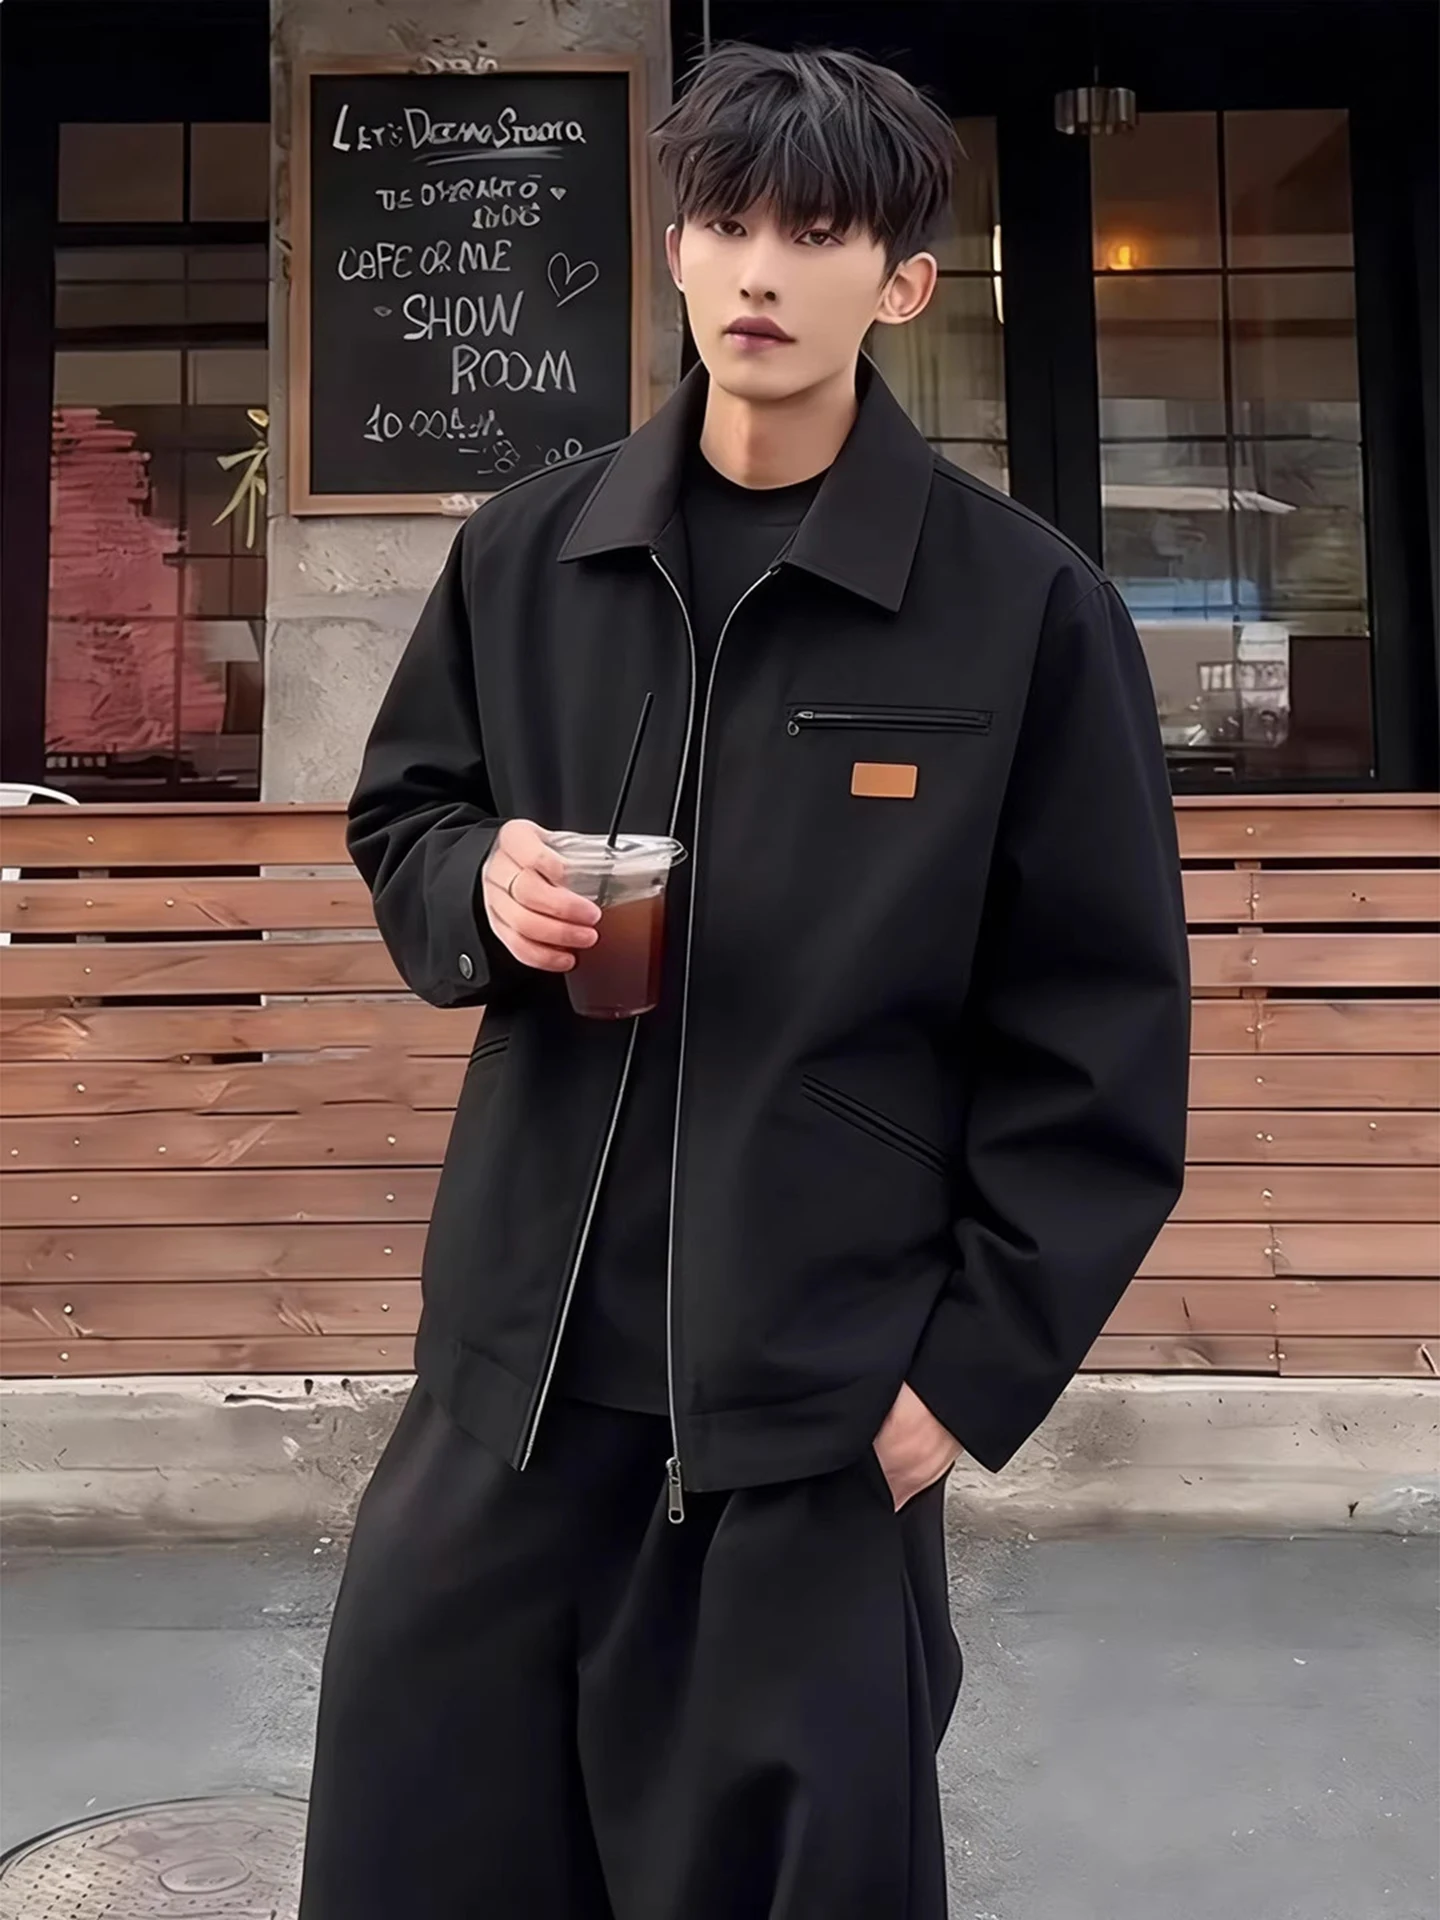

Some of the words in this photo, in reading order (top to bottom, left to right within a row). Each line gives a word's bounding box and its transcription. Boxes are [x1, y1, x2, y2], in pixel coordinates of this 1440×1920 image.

[459, 239, 512, 275] ME
[402, 290, 524, 340] SHOW
[451, 344, 577, 395] ROOM
